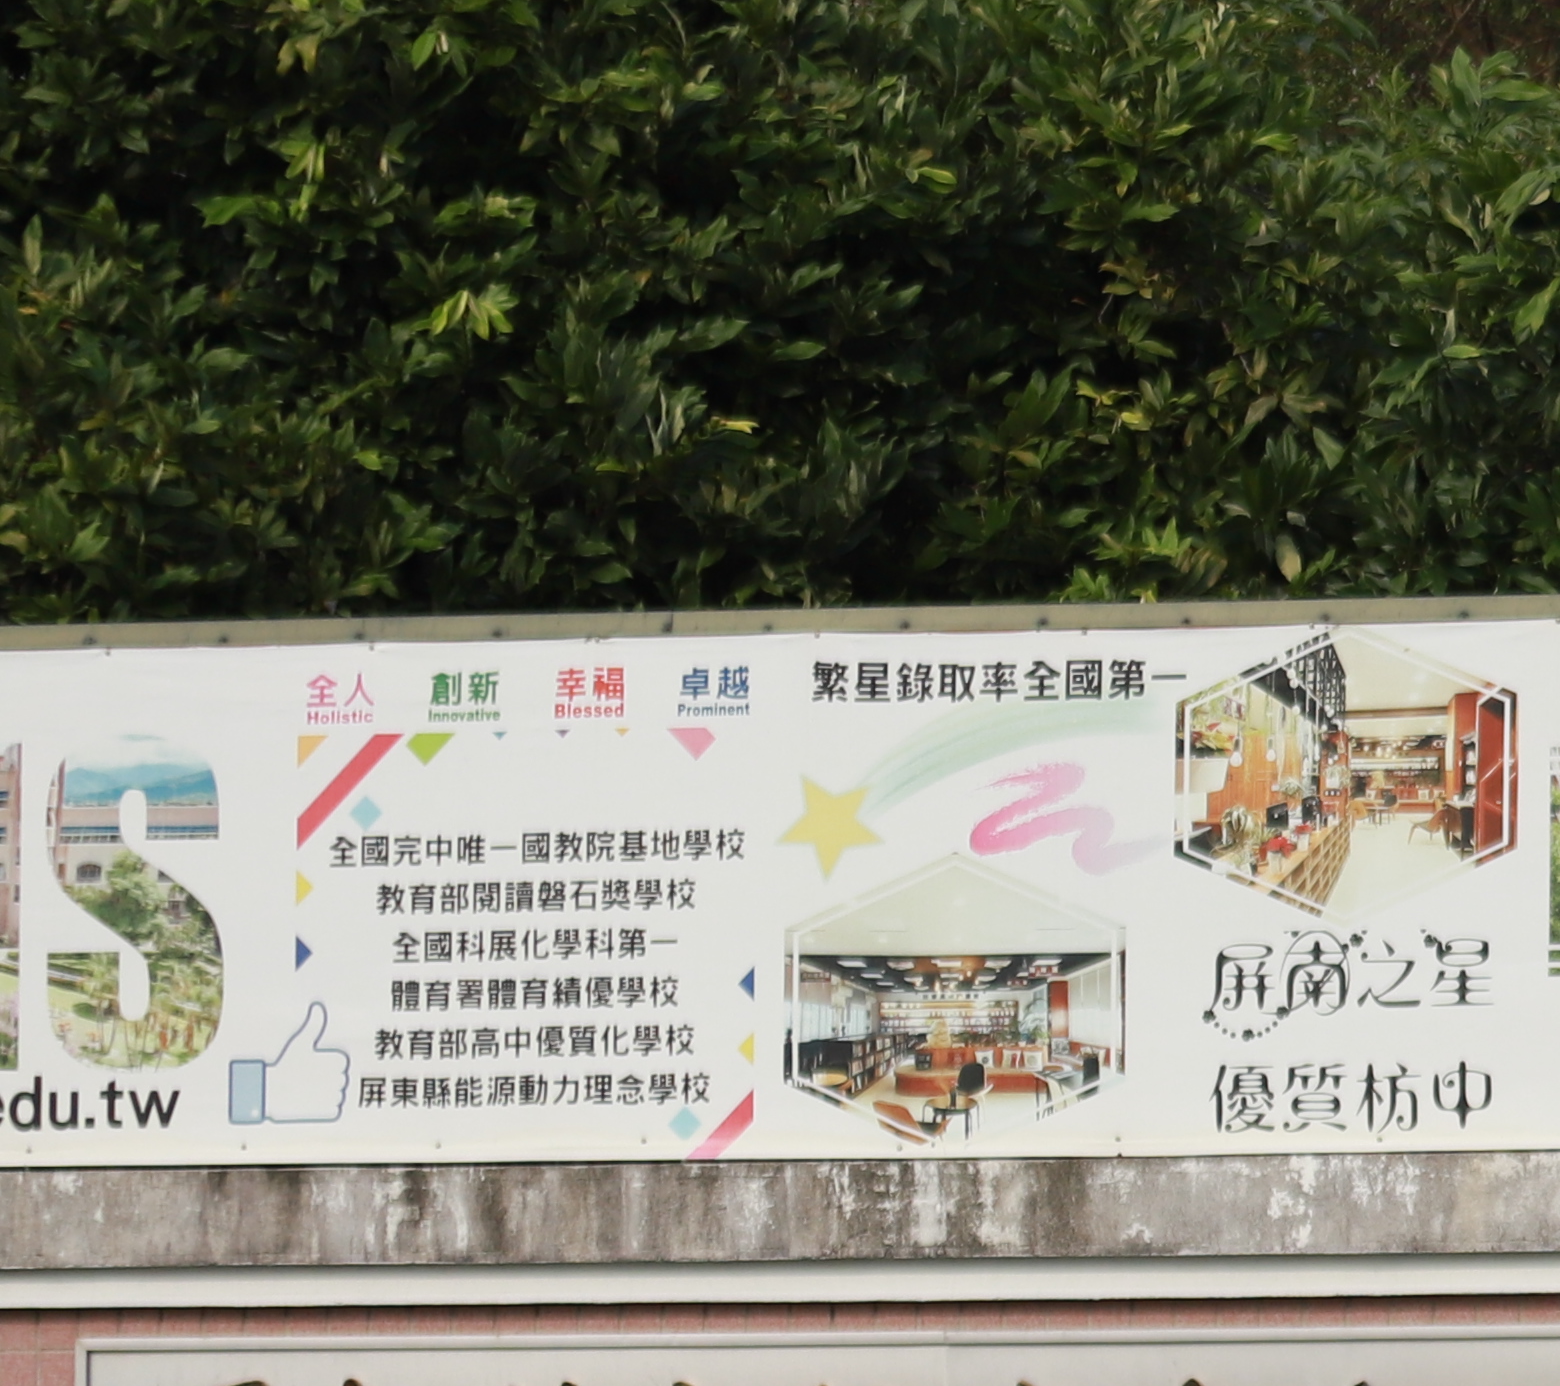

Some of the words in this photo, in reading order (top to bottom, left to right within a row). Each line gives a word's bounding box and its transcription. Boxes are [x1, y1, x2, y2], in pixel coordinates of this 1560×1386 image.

[306, 673, 375, 709] 全人
[430, 671, 500, 705] 創新
[555, 666, 625, 701] 幸福
[680, 665, 750, 700] 卓越
[812, 659, 1188, 703] 繁星錄取率全國第一
[306, 709, 373, 724] Holistic
[427, 707, 501, 722] Innovative
[554, 702, 625, 718] Blessed
[677, 701, 750, 717] Prominent
[329, 829, 745, 867] 全國完中唯一國教院基地學校
[0, 735, 224, 1071] S
[376, 878, 696, 915] 教育部閱讀磐石獎學校
[392, 928, 678, 963] 全國科展化學科第一
[1210, 931, 1494, 1015] 屏南之星
[391, 976, 679, 1011] 體育署體育績優學校
[375, 1024, 694, 1060] 教育部高中優質化學校
[358, 1072, 711, 1108] 屏東縣能源動力理念學校
[1211, 1060, 1493, 1133] 優質枋中
